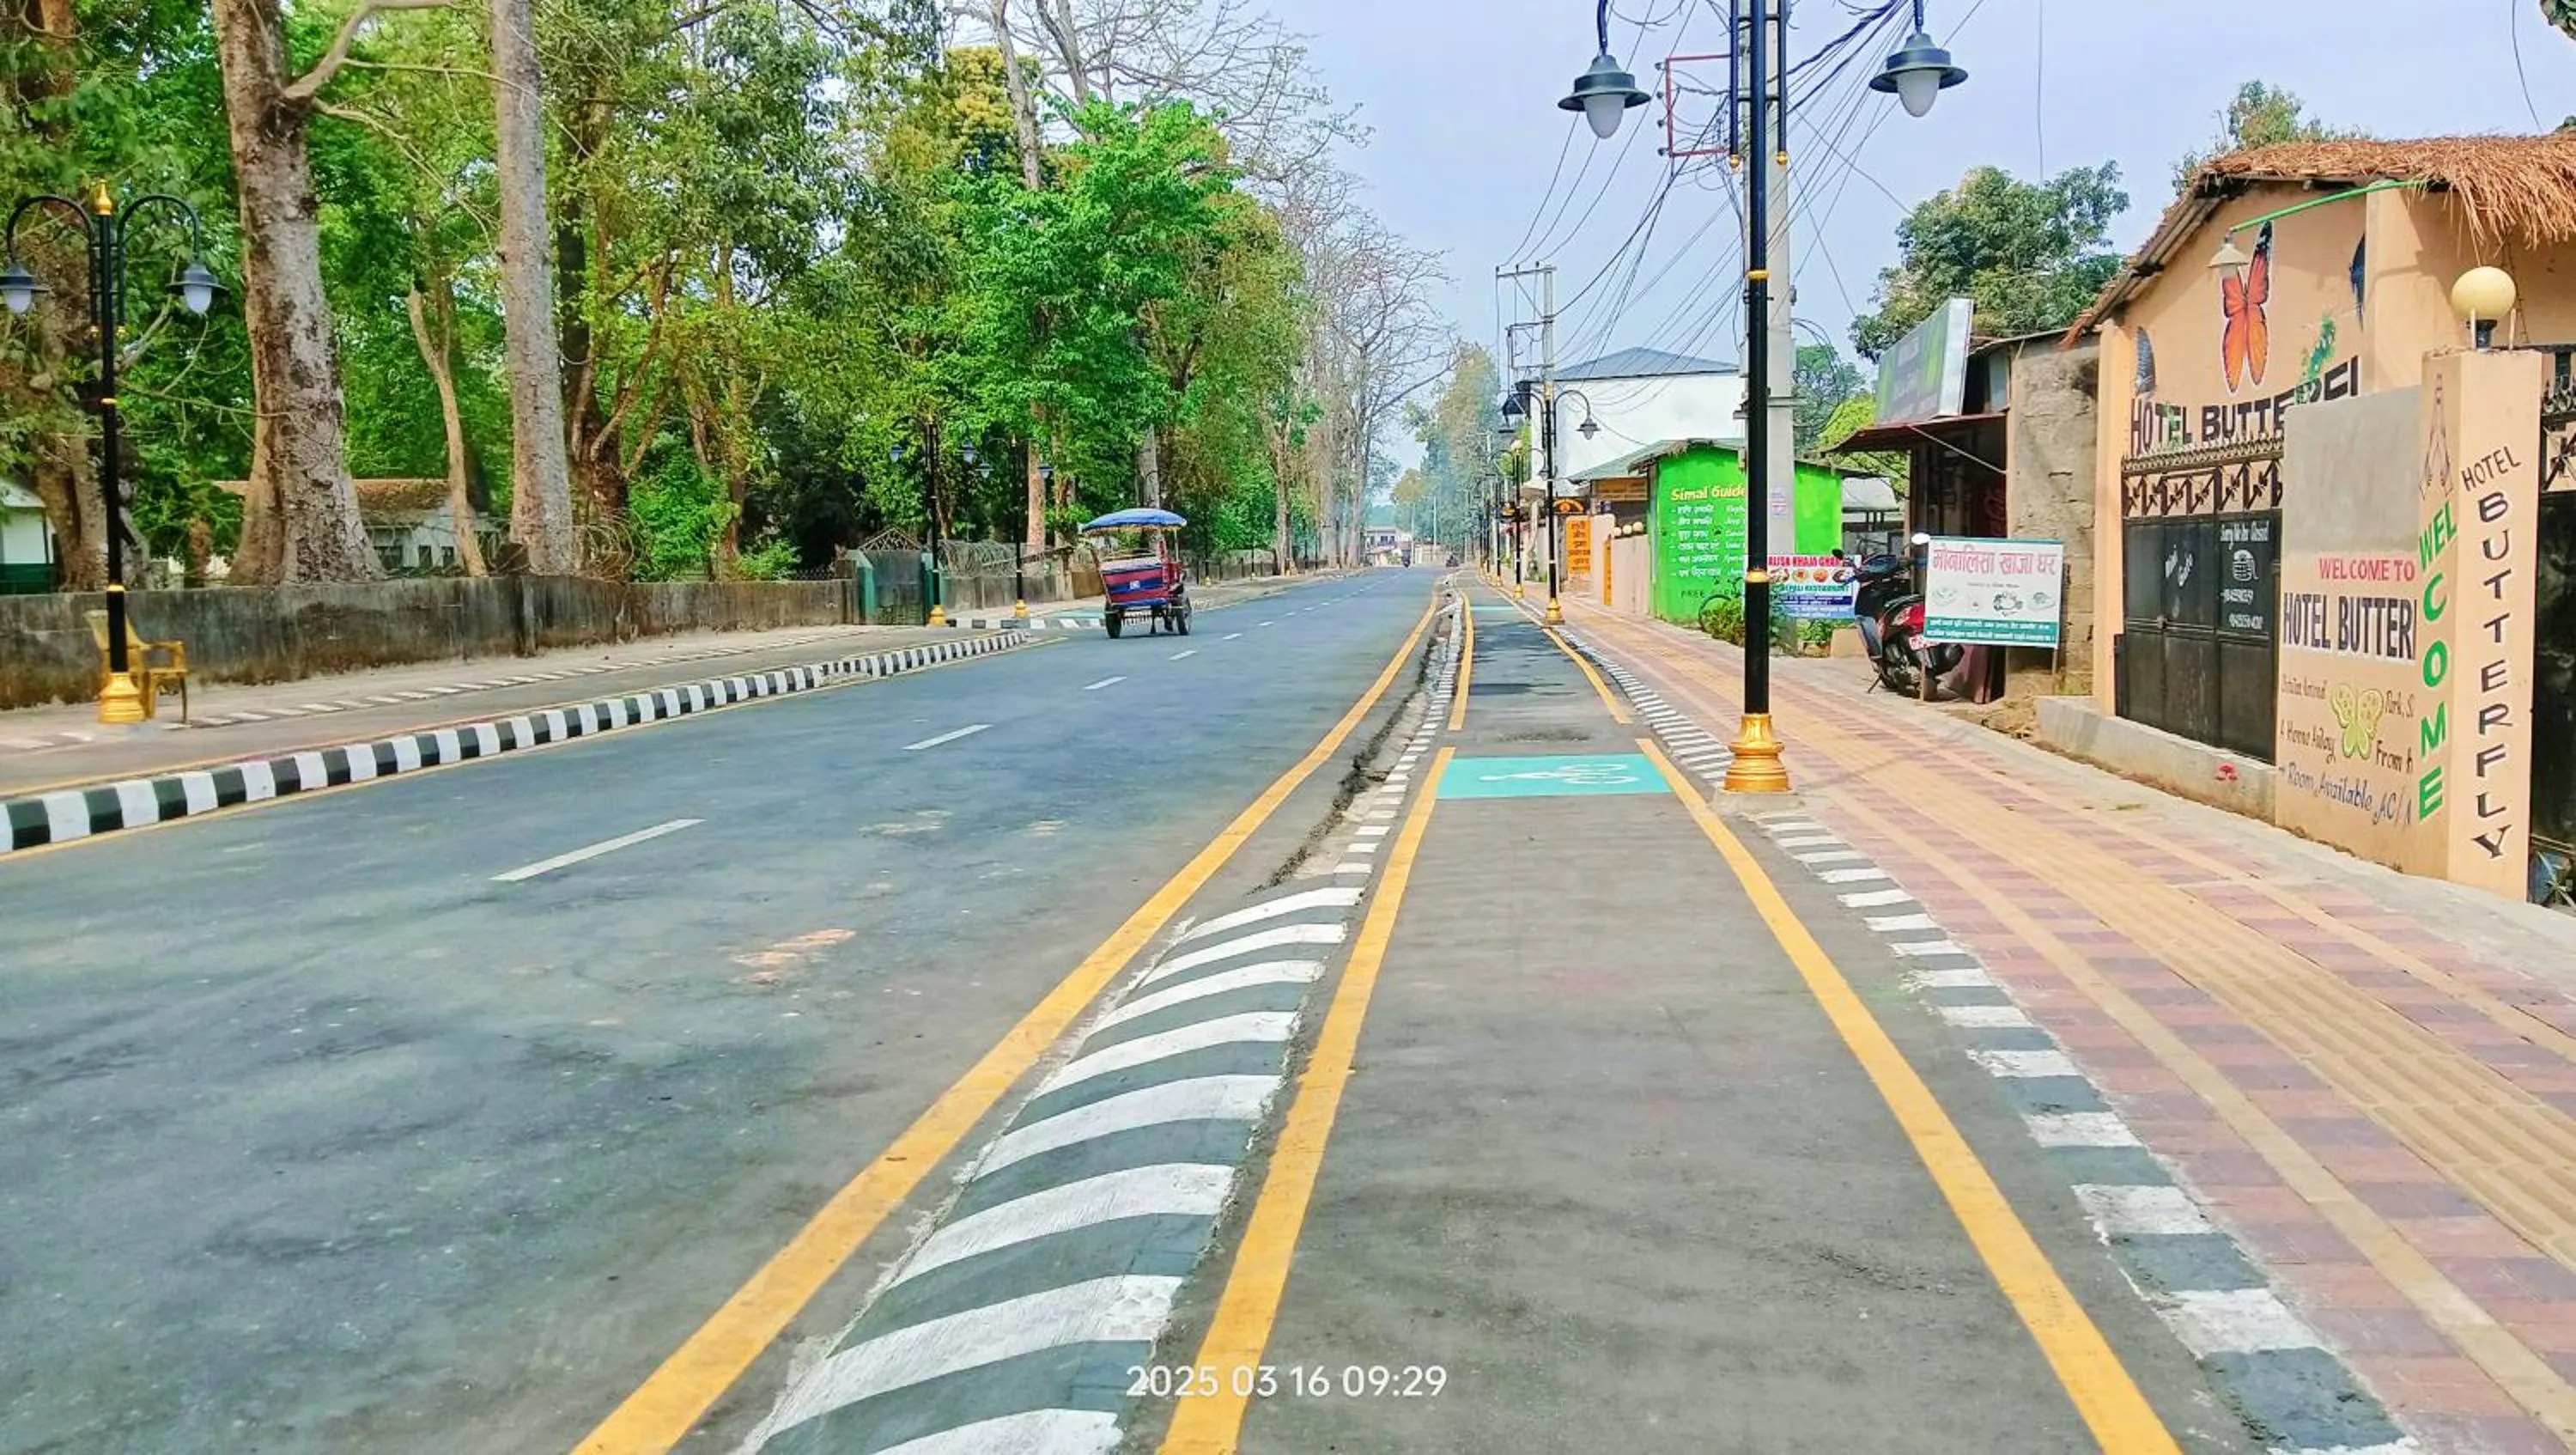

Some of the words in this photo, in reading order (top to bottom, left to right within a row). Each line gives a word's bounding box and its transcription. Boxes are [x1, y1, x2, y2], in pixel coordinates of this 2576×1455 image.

[2130, 395, 2193, 460] HOTEL
[2461, 446, 2522, 492] HOTEL
[2319, 558, 2389, 581] WELCOME
[2394, 559, 2415, 581] TO
[2283, 593, 2330, 648] HOTEL
[2471, 491, 2512, 859] BUTTERFLY
[2376, 740, 2403, 773] From
[2287, 761, 2314, 792] Room
[2315, 770, 2373, 812] Available
